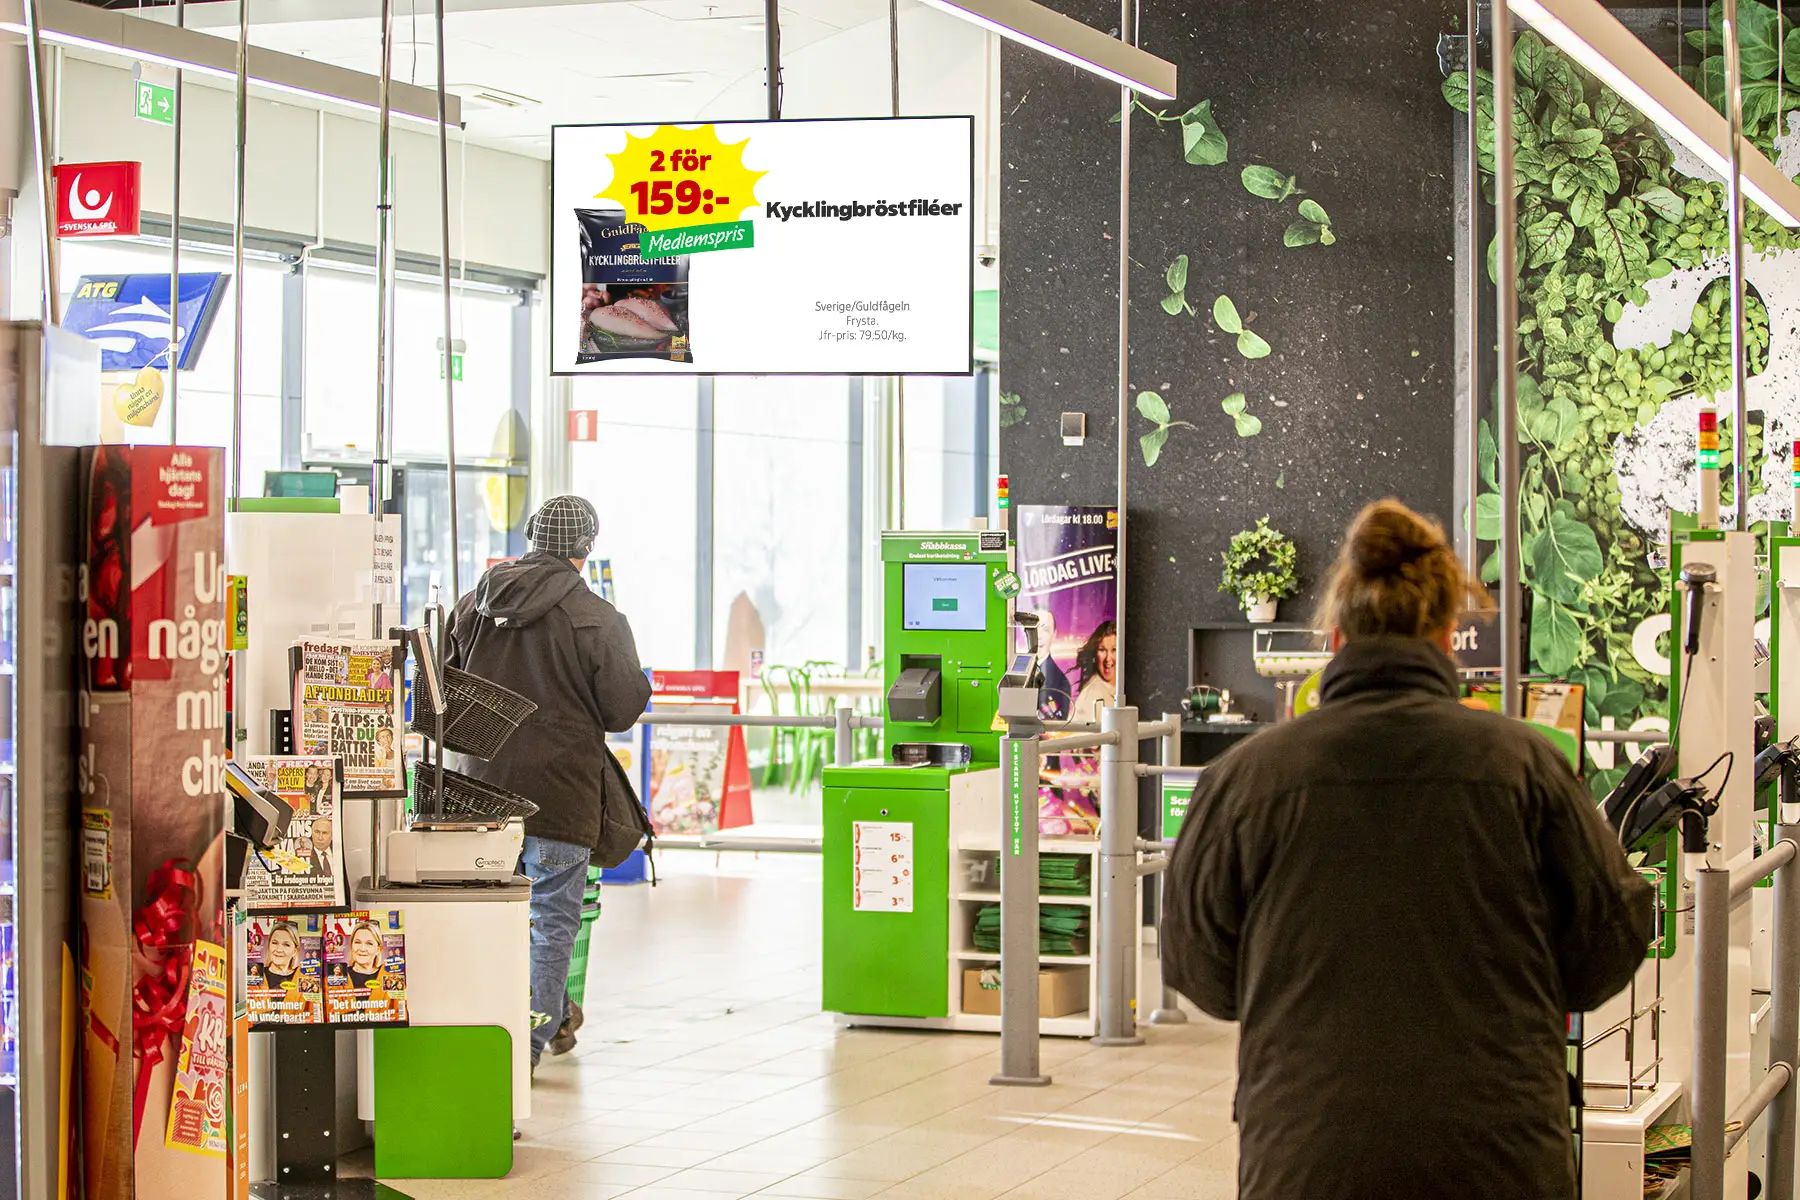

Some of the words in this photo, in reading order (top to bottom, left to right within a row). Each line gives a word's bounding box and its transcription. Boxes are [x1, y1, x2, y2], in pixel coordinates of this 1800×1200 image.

[649, 150, 665, 171] 2
[670, 149, 712, 171] för
[630, 180, 730, 215] 159:-
[766, 199, 962, 222] Kycklingbröstfiléer
[64, 222, 98, 232] SVENSKA
[649, 225, 745, 252] Medlemspris
[78, 281, 118, 299] ATG
[815, 301, 910, 313] Sverige/Guldfågeln
[846, 316, 879, 327] Frysta.
[819, 330, 857, 341] Jfr-pris:
[1041, 514, 1072, 525] Lördagar
[1072, 514, 1080, 524] kl
[1082, 514, 1103, 524] 18.00
[920, 541, 967, 551] Snabbkassa
[1079, 553, 1112, 576] LIVE
[304, 641, 339, 655] fredag
[308, 665, 325, 673] MELLO
[304, 684, 393, 703] AFTONBLADET
[331, 713, 340, 726] 4
[343, 714, 375, 728] TIPS:
[331, 726, 354, 740] FÅR
[356, 728, 375, 741] DU
[331, 740, 375, 754] BÄTTRE
[332, 753, 375, 768] INNE
[278, 768, 304, 777] CASPERS
[278, 777, 289, 785] NYA
[290, 777, 299, 785] LIV
[1170, 806, 1184, 817] för
[268, 999, 304, 1010] kommer
[351, 999, 389, 1010] kommer
[329, 1012, 341, 1023] bli
